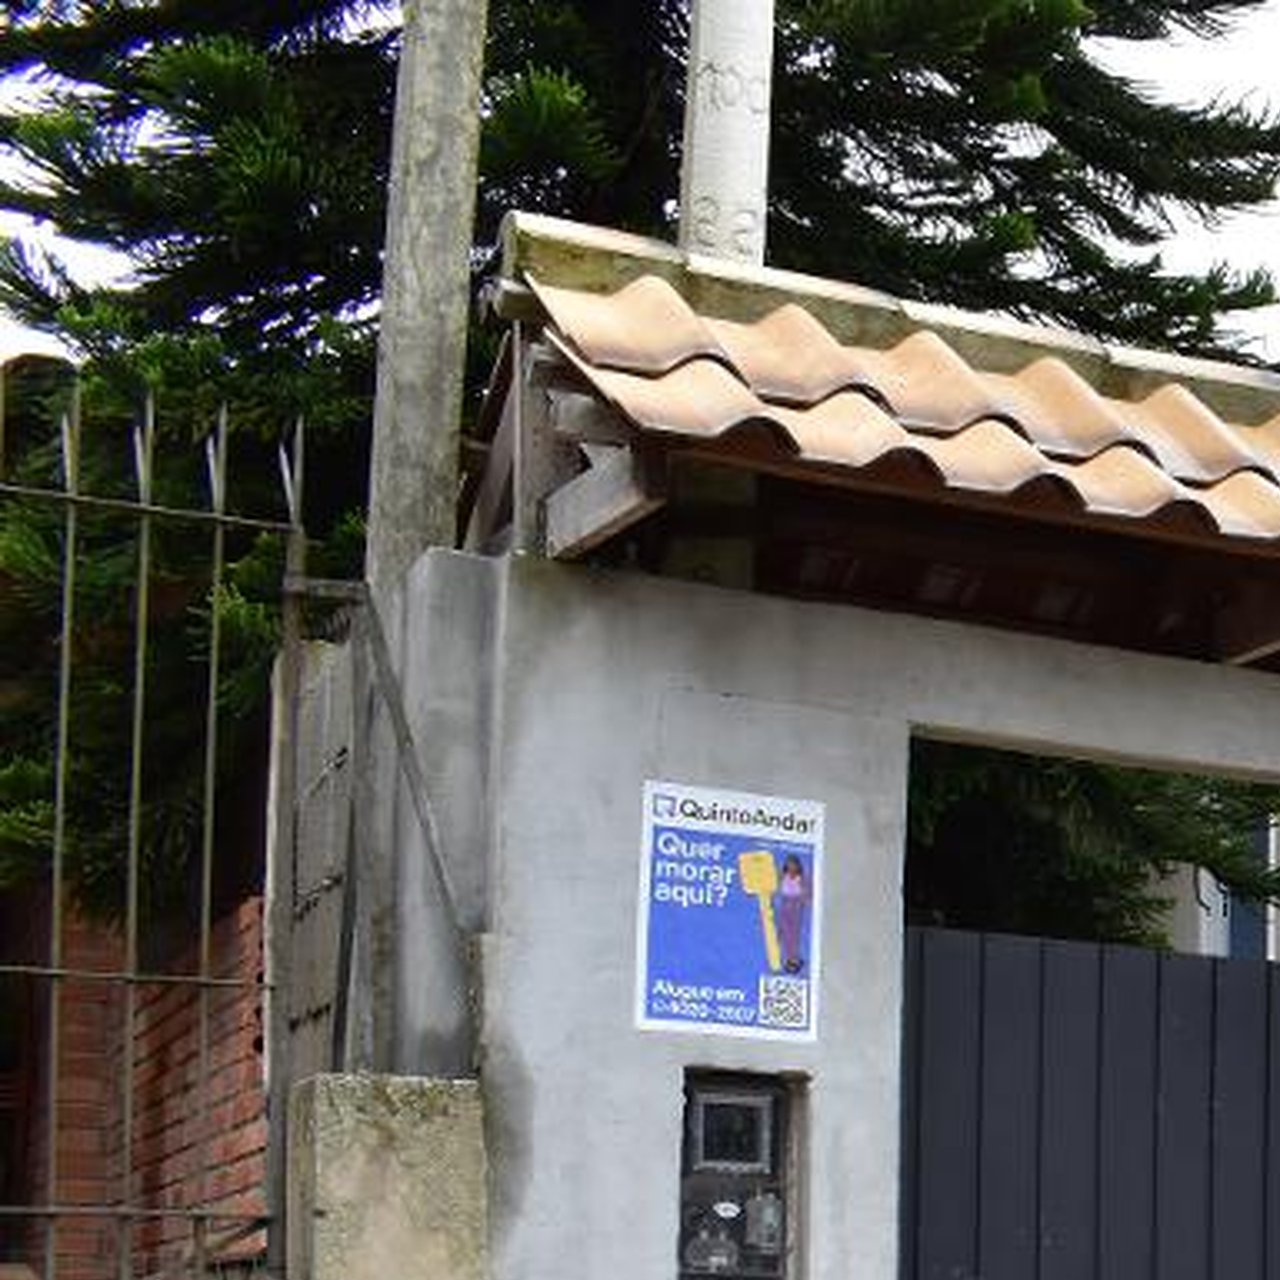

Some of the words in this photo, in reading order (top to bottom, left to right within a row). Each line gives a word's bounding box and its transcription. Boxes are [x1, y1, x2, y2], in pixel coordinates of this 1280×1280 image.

[680, 800, 816, 833] QuintoAndar
[656, 832, 727, 861] Quer
[655, 860, 737, 884] morar
[654, 883, 728, 908] aqui?
